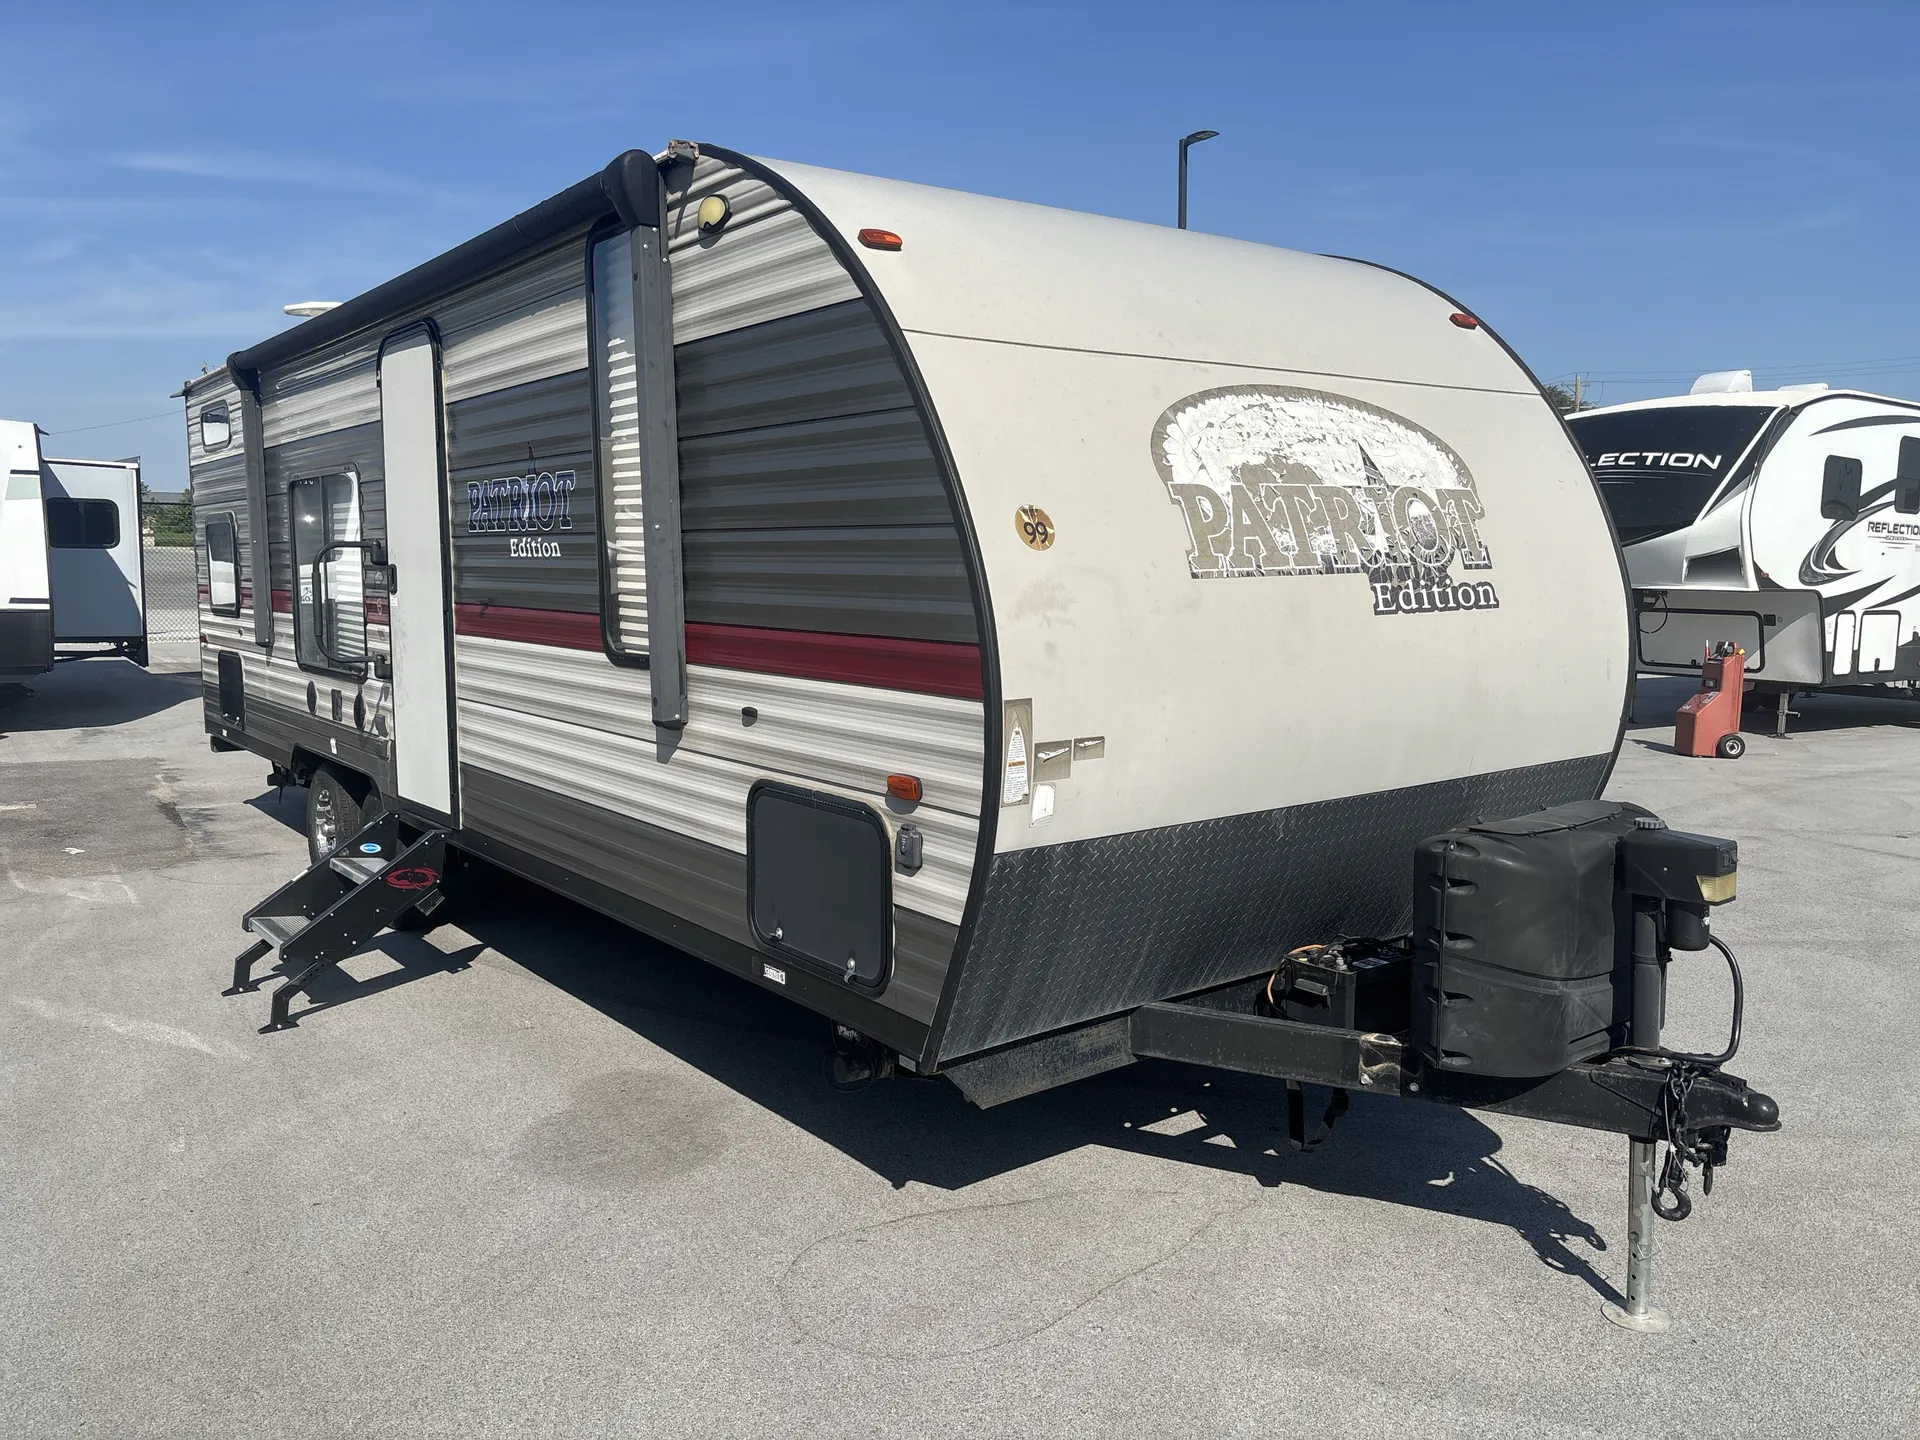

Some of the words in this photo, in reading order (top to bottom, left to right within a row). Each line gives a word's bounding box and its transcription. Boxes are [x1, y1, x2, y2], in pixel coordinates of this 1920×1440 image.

[1586, 452, 1722, 470] ECTION
[467, 470, 576, 533] PATRIOT
[1023, 521, 1049, 545] 99
[1168, 482, 1489, 575] PATRIOT
[1867, 521, 1920, 536] REFLECTIO
[509, 536, 562, 558] Edition
[1373, 578, 1498, 612] Edition
